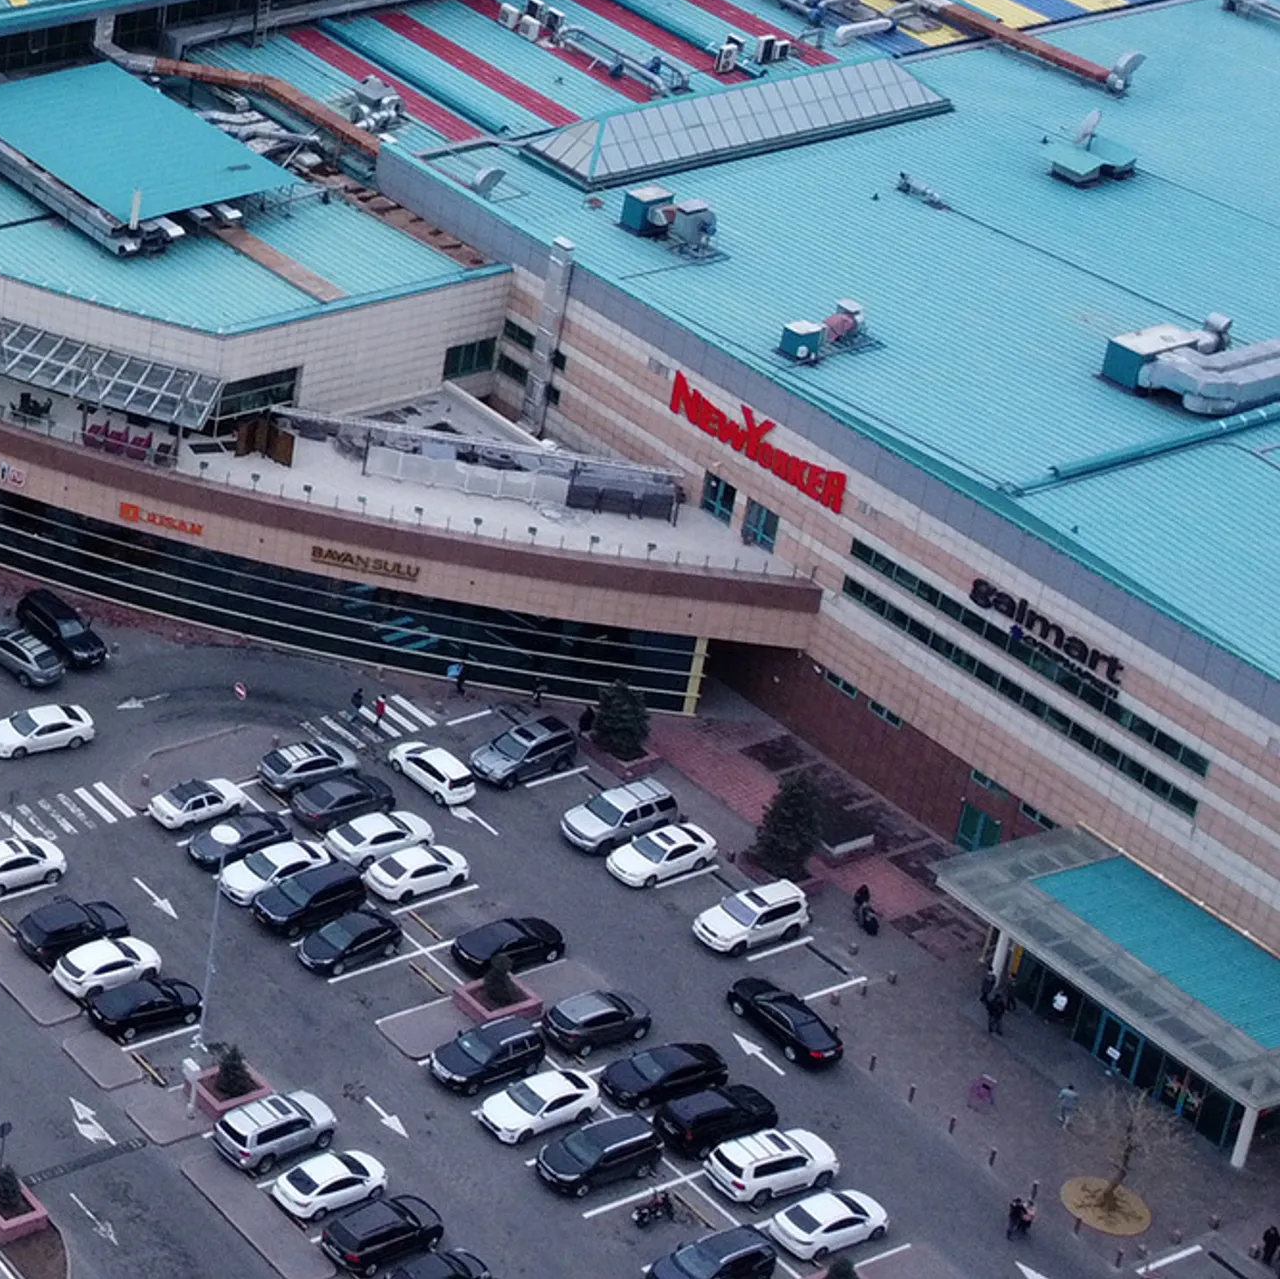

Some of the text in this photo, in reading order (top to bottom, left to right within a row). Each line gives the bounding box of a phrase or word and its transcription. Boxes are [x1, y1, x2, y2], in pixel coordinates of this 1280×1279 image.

[312, 546, 420, 578] BAYAN SULU
[969, 578, 1124, 684] galmart
